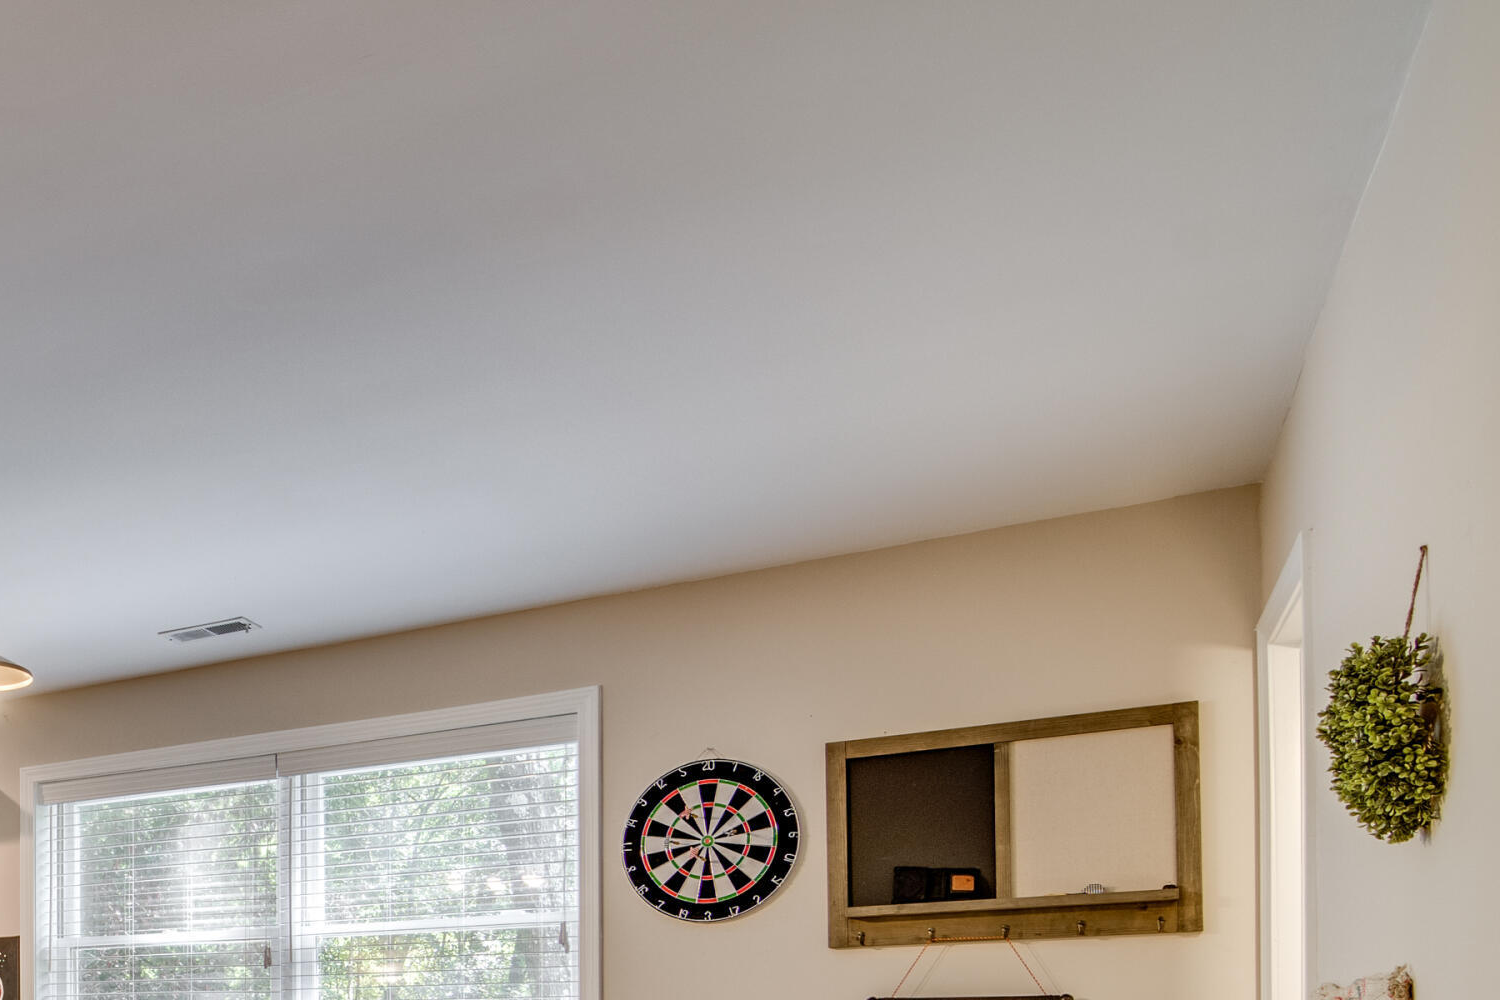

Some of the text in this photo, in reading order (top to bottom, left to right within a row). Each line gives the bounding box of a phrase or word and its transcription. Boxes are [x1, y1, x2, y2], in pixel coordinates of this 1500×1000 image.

[701, 760, 715, 771] 20
[678, 767, 687, 777] 5
[752, 768, 765, 781] 18
[653, 779, 667, 790] 12
[773, 787, 783, 796] 4
[637, 798, 647, 807] 9
[783, 804, 795, 817] 13
[626, 818, 638, 828] 14
[788, 831, 798, 839] 6
[623, 842, 633, 852] 11
[783, 853, 795, 864] 10
[771, 875, 783, 886] 15
[636, 884, 649, 895] 16
[655, 899, 665, 909] 7
[752, 894, 762, 905] 2
[678, 908, 688, 919] 19
[704, 910, 713, 920] 3
[728, 905, 740, 917] 17
